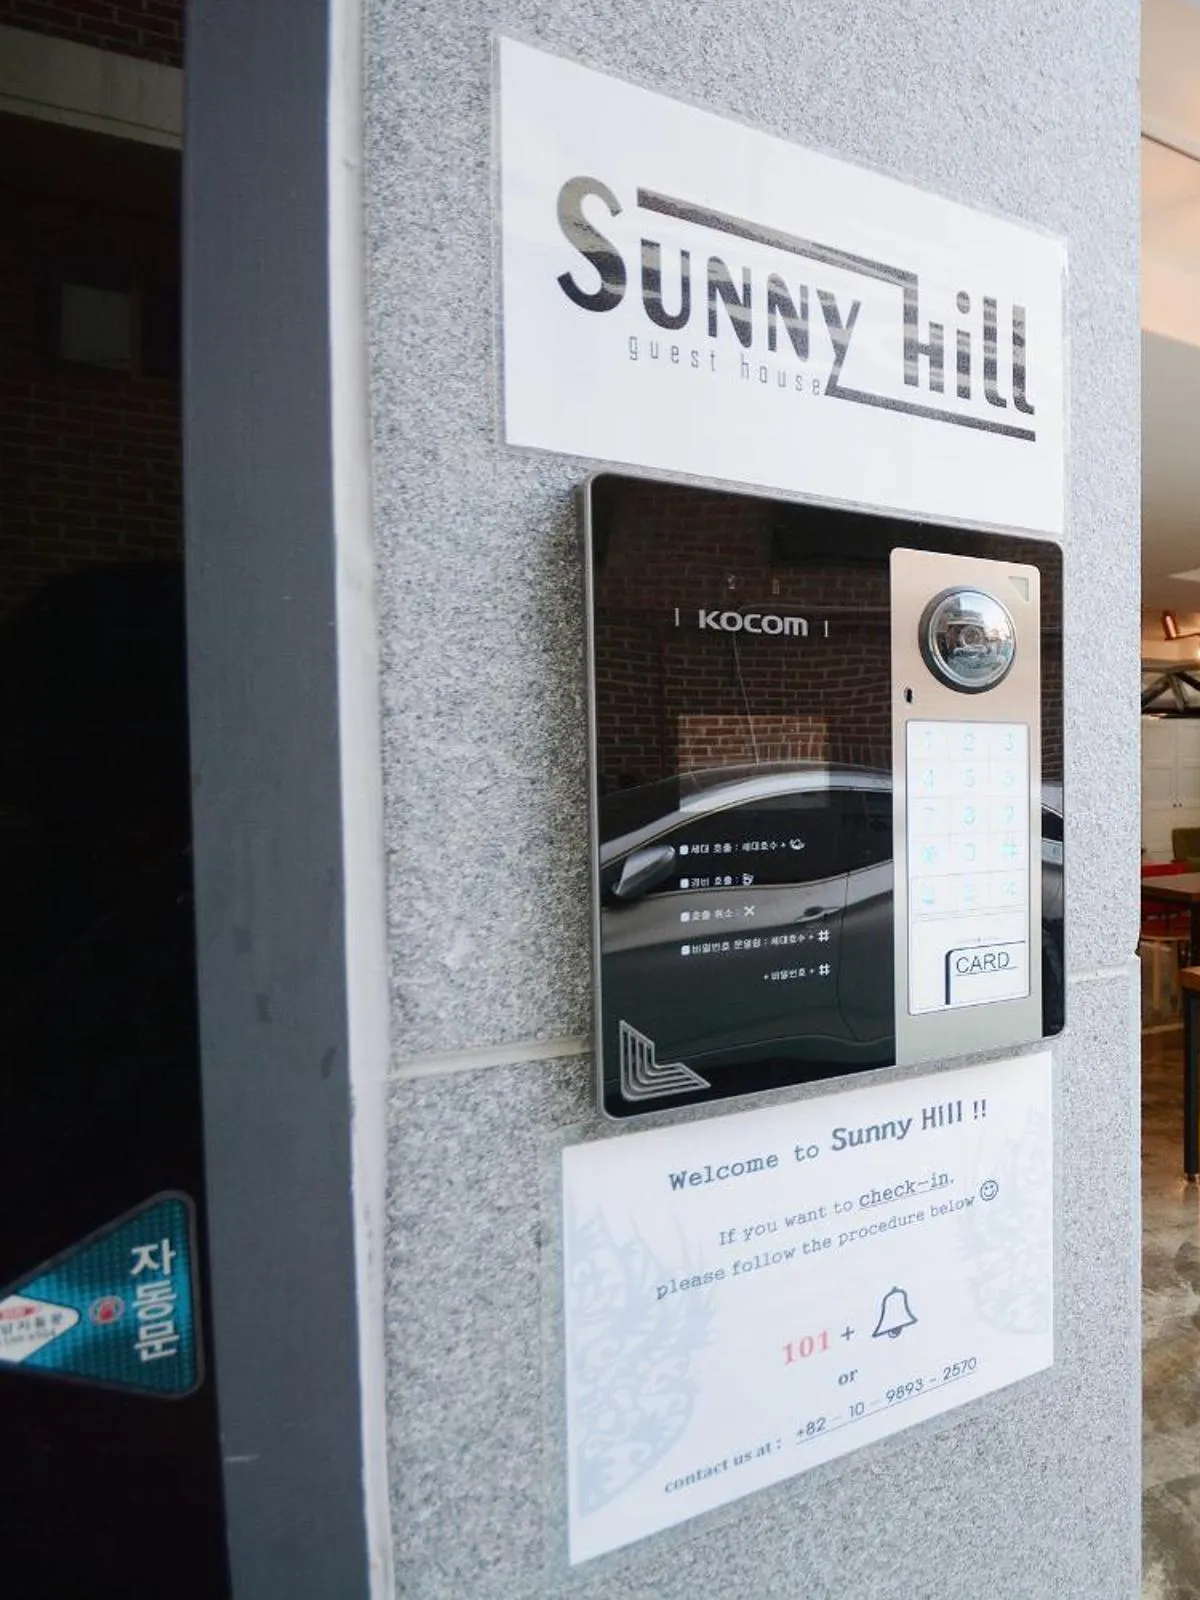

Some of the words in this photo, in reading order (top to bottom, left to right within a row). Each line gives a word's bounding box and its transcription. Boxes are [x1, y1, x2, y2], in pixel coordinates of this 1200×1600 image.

[628, 335, 716, 372] guest
[740, 358, 821, 396] house
[956, 951, 1010, 973] CARD
[669, 1153, 778, 1191] Welcome
[794, 1144, 819, 1161] to
[831, 1117, 912, 1151] Sunny
[921, 1100, 963, 1131] Hill
[655, 1268, 726, 1300] please
[732, 1248, 796, 1276] follow
[802, 1235, 832, 1255] the
[838, 1210, 925, 1247] procedure
[930, 1195, 976, 1217] below
[719, 1228, 736, 1246] If
[743, 1221, 778, 1242] you
[784, 1206, 828, 1228] want
[834, 1200, 853, 1215] to
[130, 1237, 181, 1363] 자동문
[783, 1329, 831, 1365] 101
[838, 1368, 859, 1386] or
[664, 1459, 728, 1494] contact
[733, 1450, 753, 1466] us
[849, 1401, 865, 1418] 10
[886, 1378, 924, 1403] 9893
[942, 1357, 977, 1381] 2570
